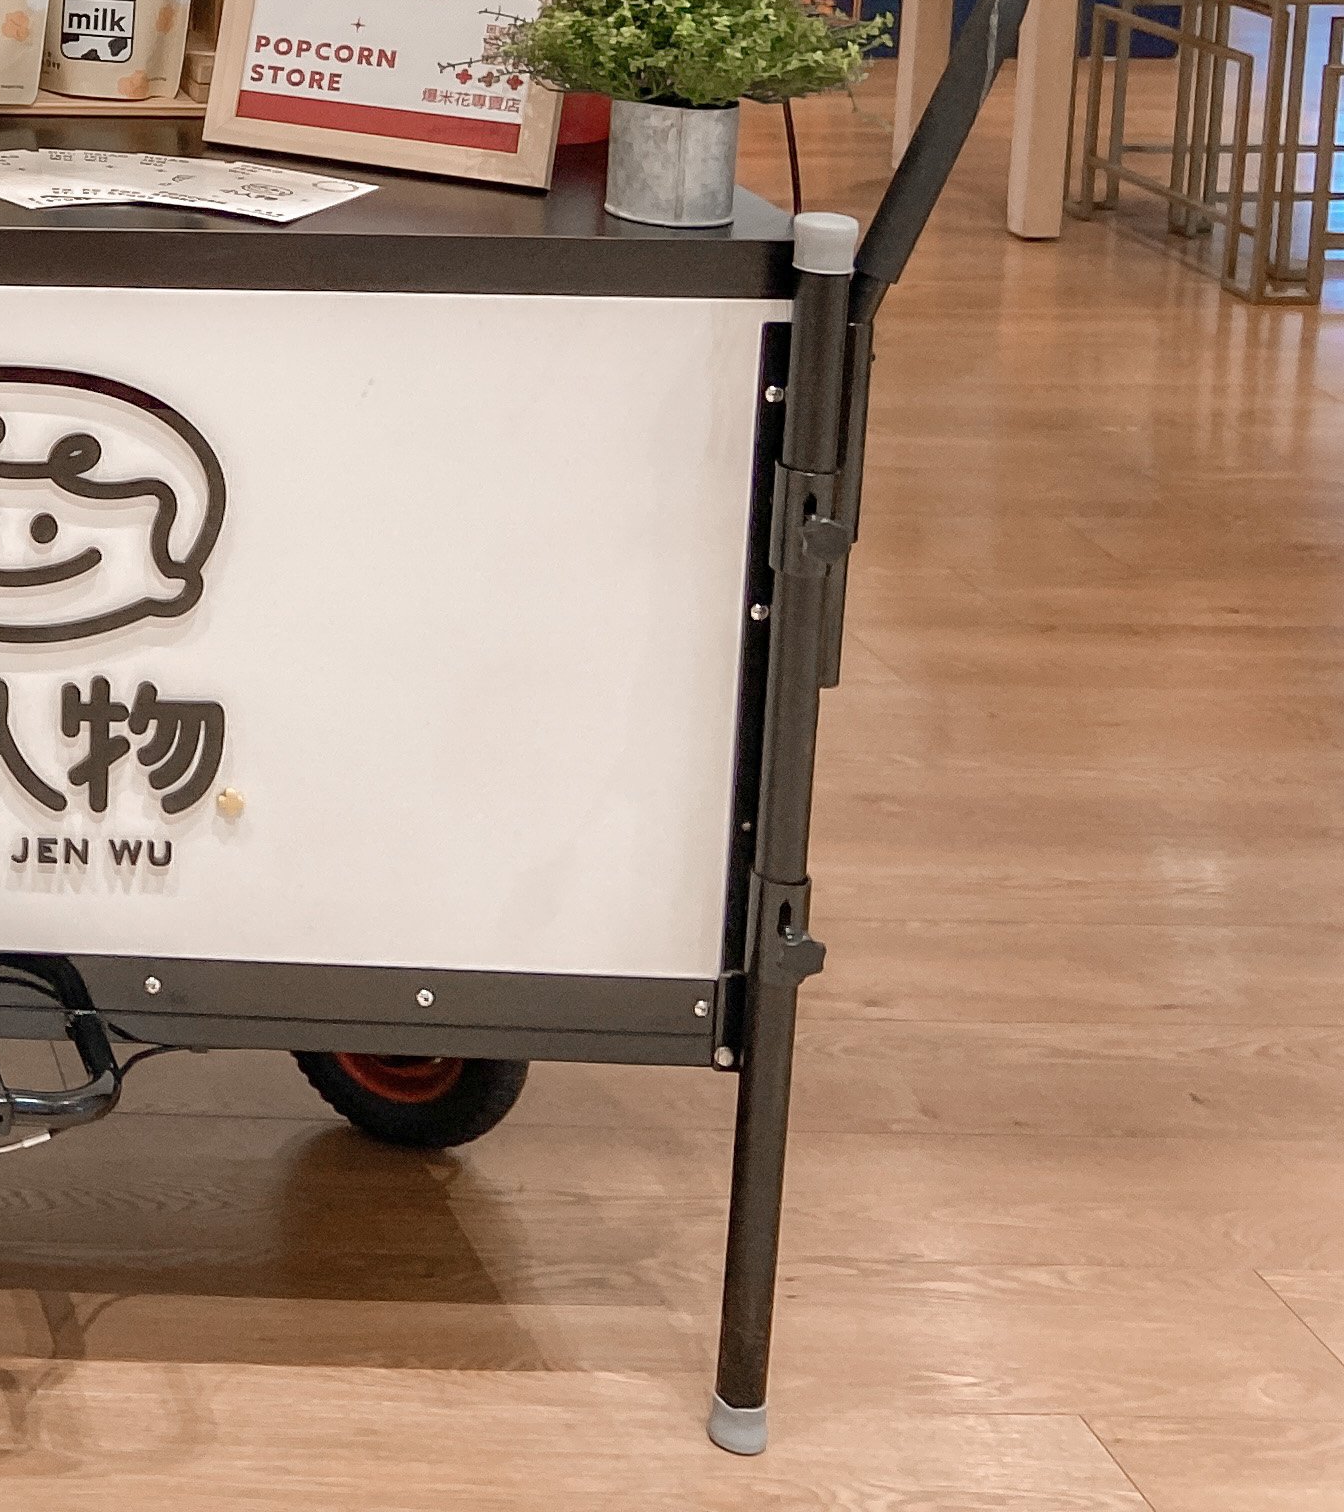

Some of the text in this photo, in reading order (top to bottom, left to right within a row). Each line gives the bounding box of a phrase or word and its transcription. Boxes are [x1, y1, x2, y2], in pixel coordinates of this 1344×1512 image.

[68, 7, 126, 33] milk
[254, 34, 398, 69] POPCORN
[249, 63, 343, 92] STORE
[11, 836, 90, 865] JEN
[108, 838, 173, 868] WU
